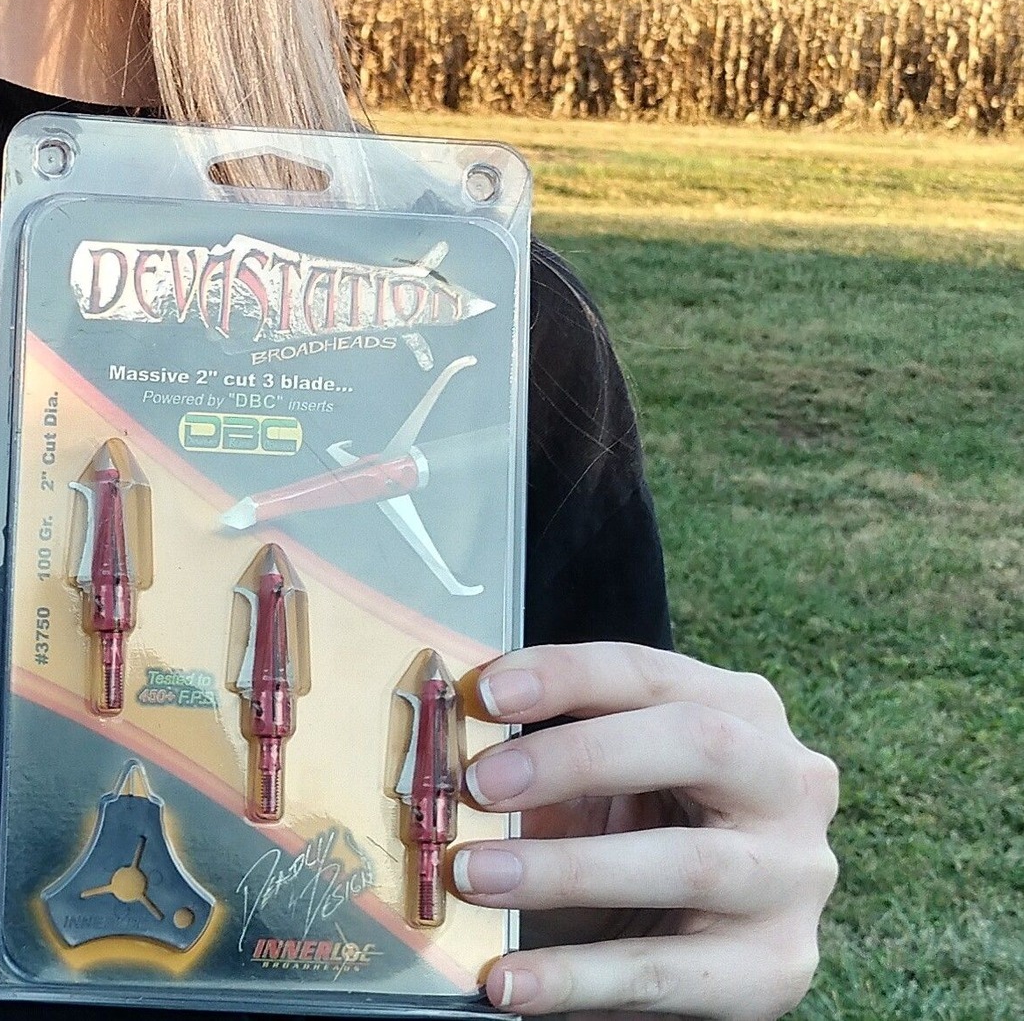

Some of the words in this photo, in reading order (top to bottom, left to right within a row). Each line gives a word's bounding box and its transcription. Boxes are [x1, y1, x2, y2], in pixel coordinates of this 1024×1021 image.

[86, 247, 465, 343] DEVASTATION
[251, 336, 397, 366] BROADHEADS
[109, 365, 189, 384] Massive
[196, 370, 217, 385] 2"
[223, 375, 256, 388] cut
[262, 375, 274, 389] 3
[281, 375, 354, 393] blade...
[44, 390, 59, 428] Dia.
[142, 391, 204, 406] Powered
[207, 394, 225, 410] by
[229, 393, 284, 409] "DBC"
[288, 398, 334, 413] inserts
[42, 432, 57, 465] Cut
[183, 414, 299, 453] DBC
[40, 516, 54, 542] Gr.
[38, 548, 52, 581] 100
[34, 607, 51, 665] #3750
[148, 670, 195, 686] Tested
[253, 938, 376, 962] INNERLOC
